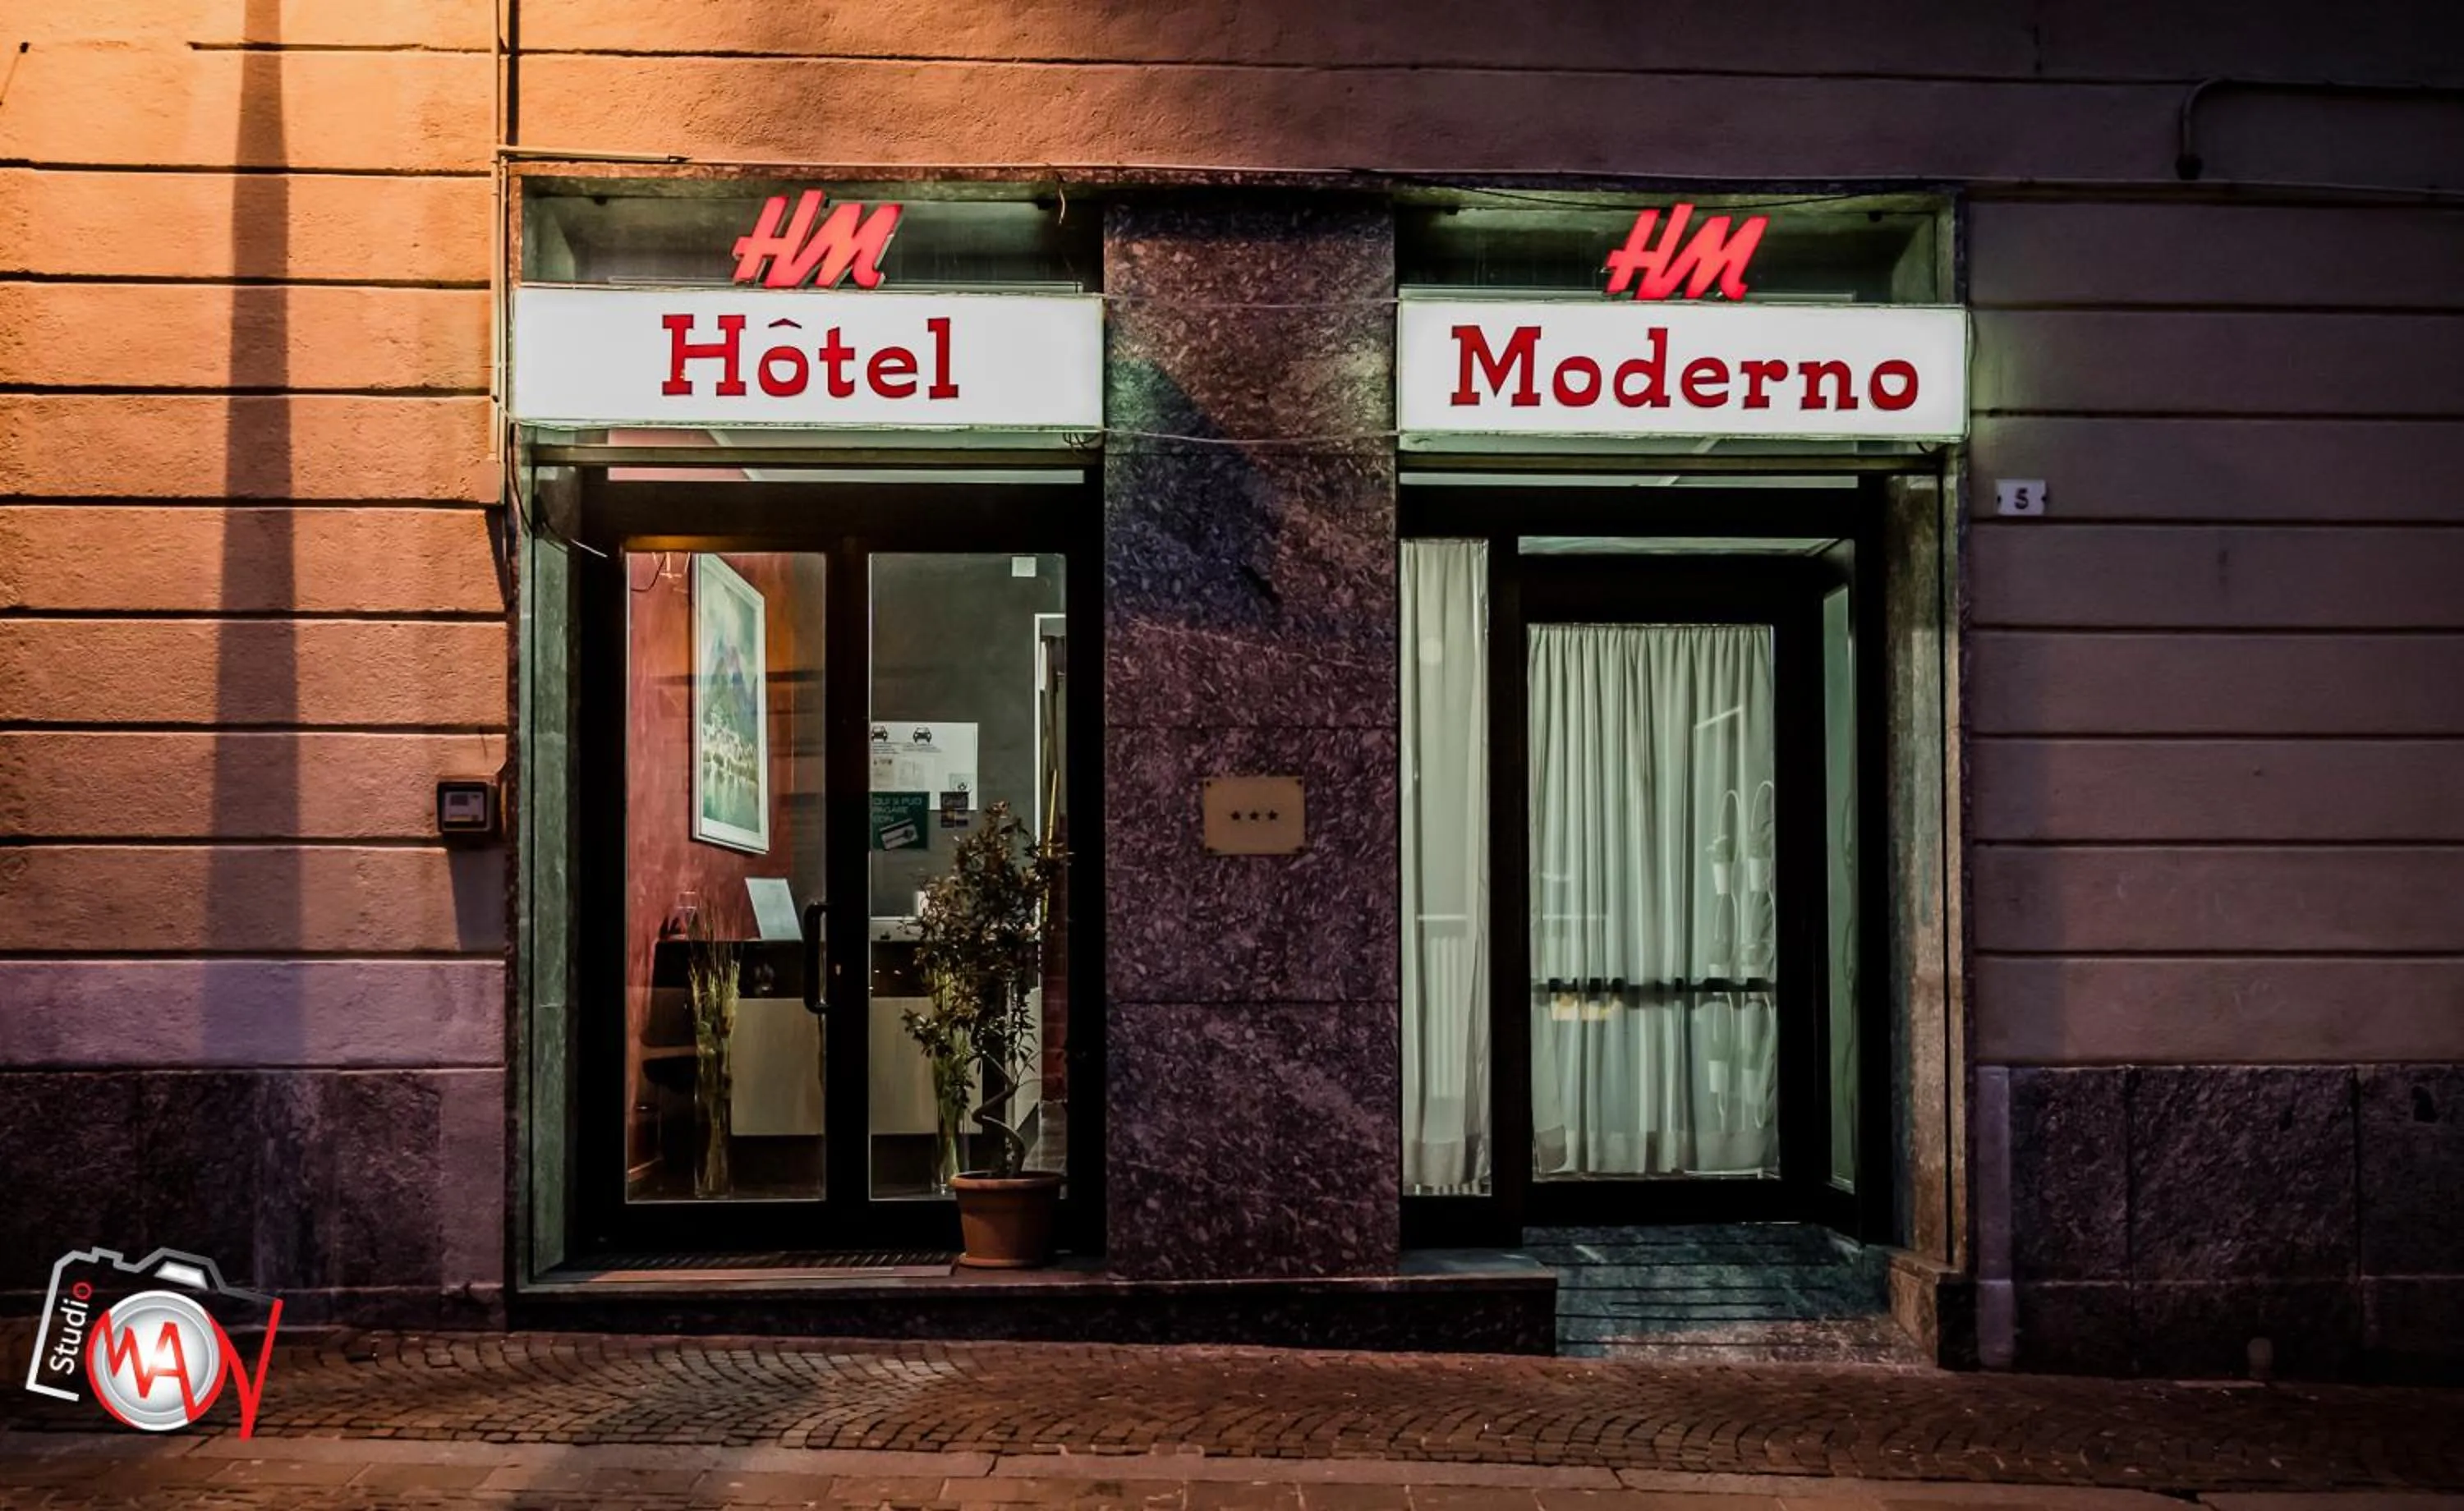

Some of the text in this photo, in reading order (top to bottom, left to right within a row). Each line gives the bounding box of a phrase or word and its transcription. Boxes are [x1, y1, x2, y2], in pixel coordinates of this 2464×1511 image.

[732, 190, 903, 289] HM
[1605, 203, 1770, 301] HM
[661, 314, 1919, 411] Hôtel Moderno
[2014, 487, 2029, 510] 5
